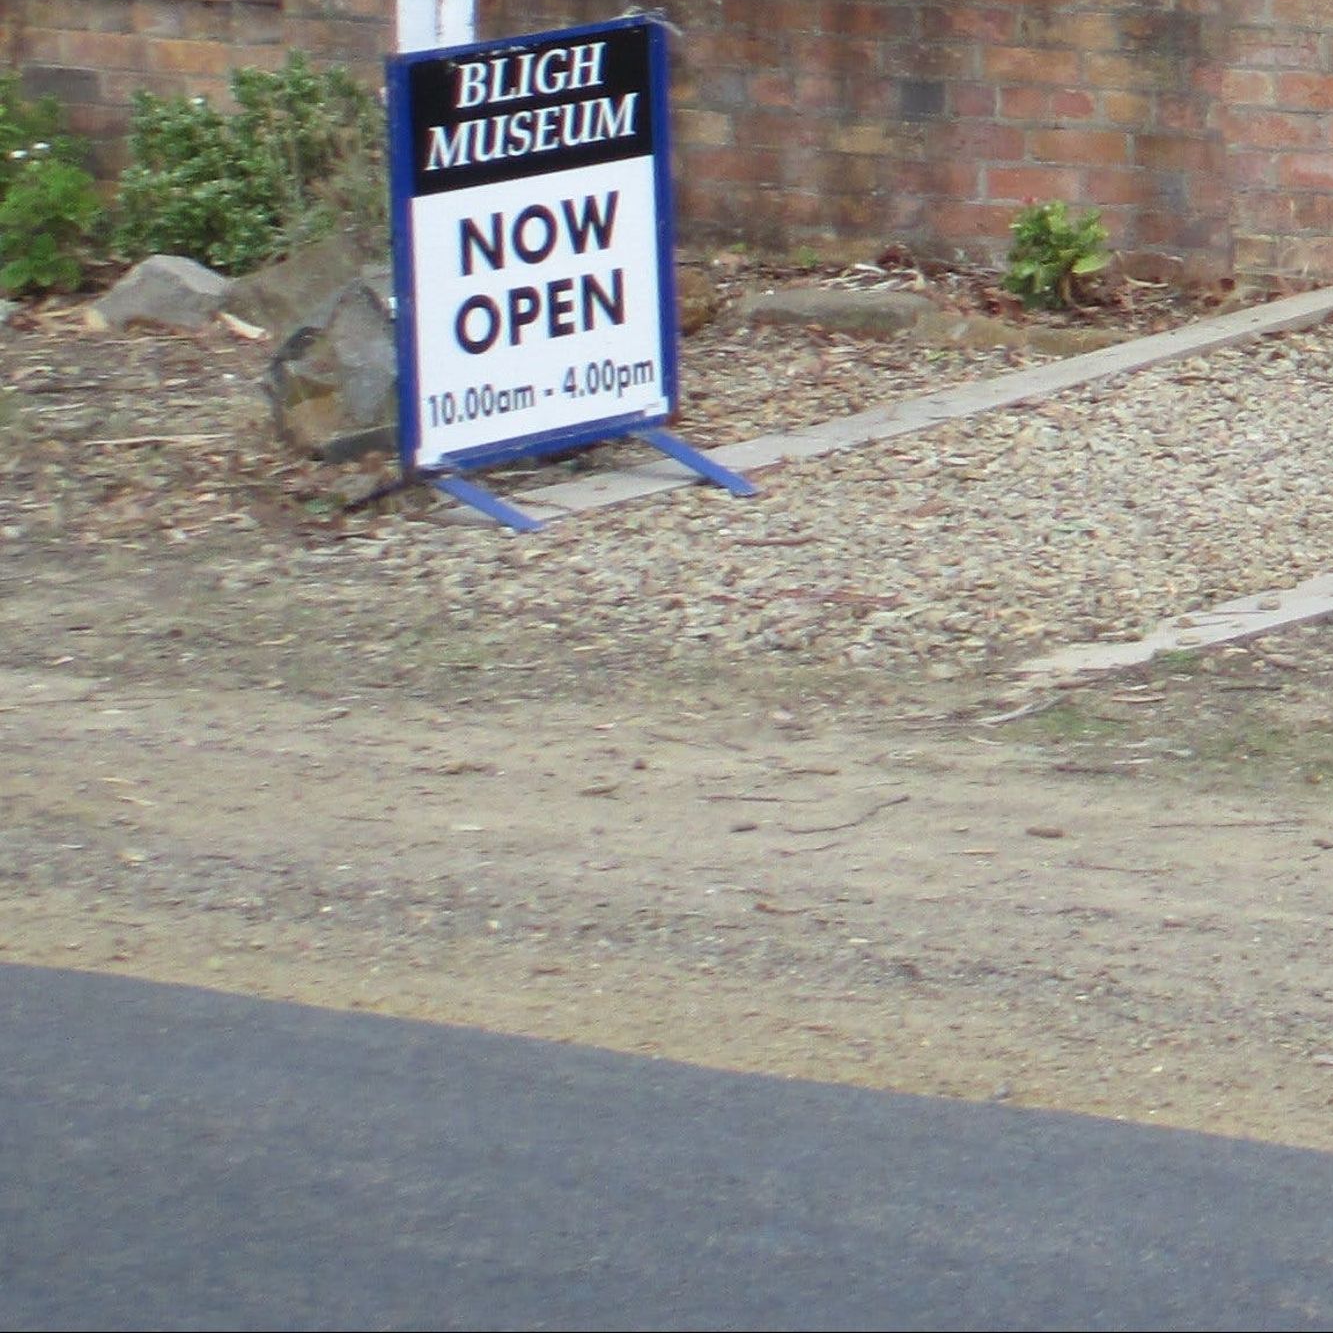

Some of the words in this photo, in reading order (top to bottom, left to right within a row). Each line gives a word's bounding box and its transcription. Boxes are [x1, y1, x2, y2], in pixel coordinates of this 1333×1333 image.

[456, 42, 607, 109] BLIGH
[424, 93, 640, 171] MUSEUM
[459, 190, 620, 276] NOW
[454, 268, 626, 355] OPEN
[427, 383, 535, 428] 10.00am
[561, 357, 655, 400] 4.00pm
